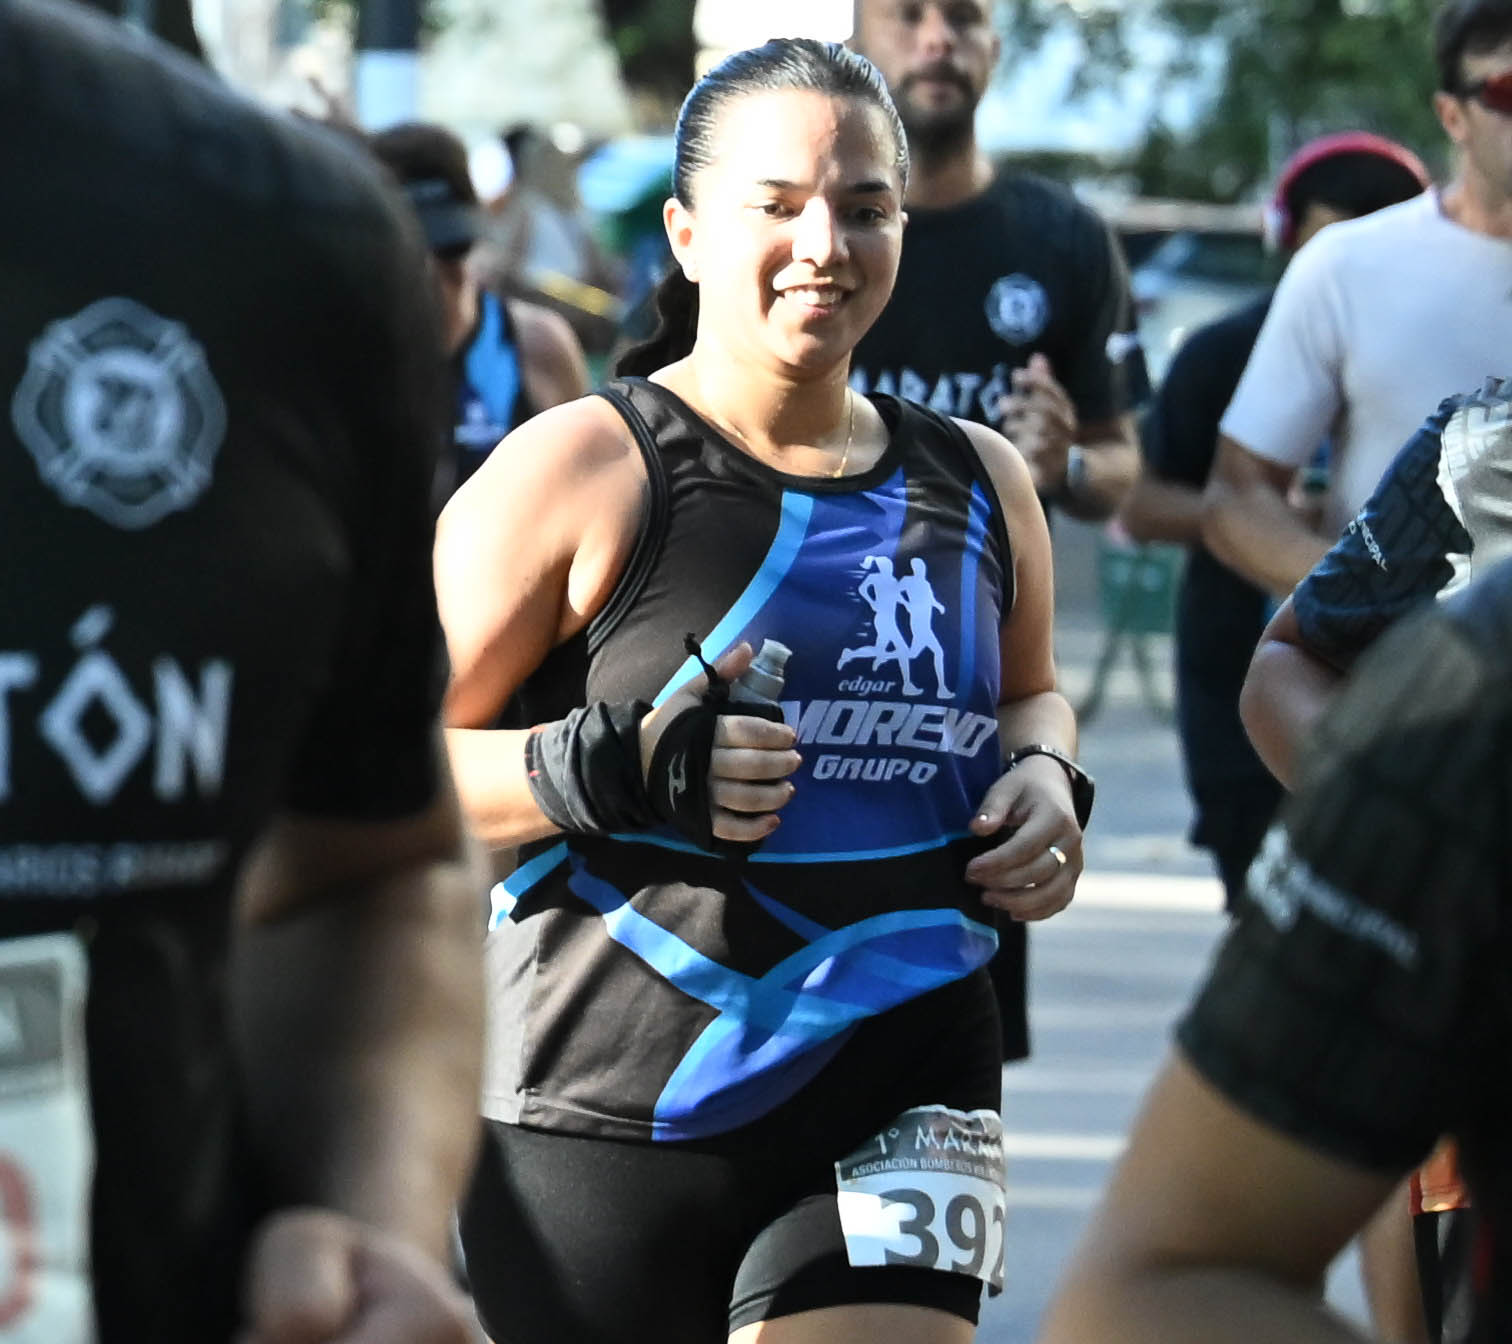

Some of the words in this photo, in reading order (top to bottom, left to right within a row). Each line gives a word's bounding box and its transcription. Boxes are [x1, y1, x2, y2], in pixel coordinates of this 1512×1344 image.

[849, 353, 1010, 423] ARATÓ
[838, 675, 896, 697] edgar
[780, 699, 999, 759] MORENO
[812, 754, 939, 785] GRUPO
